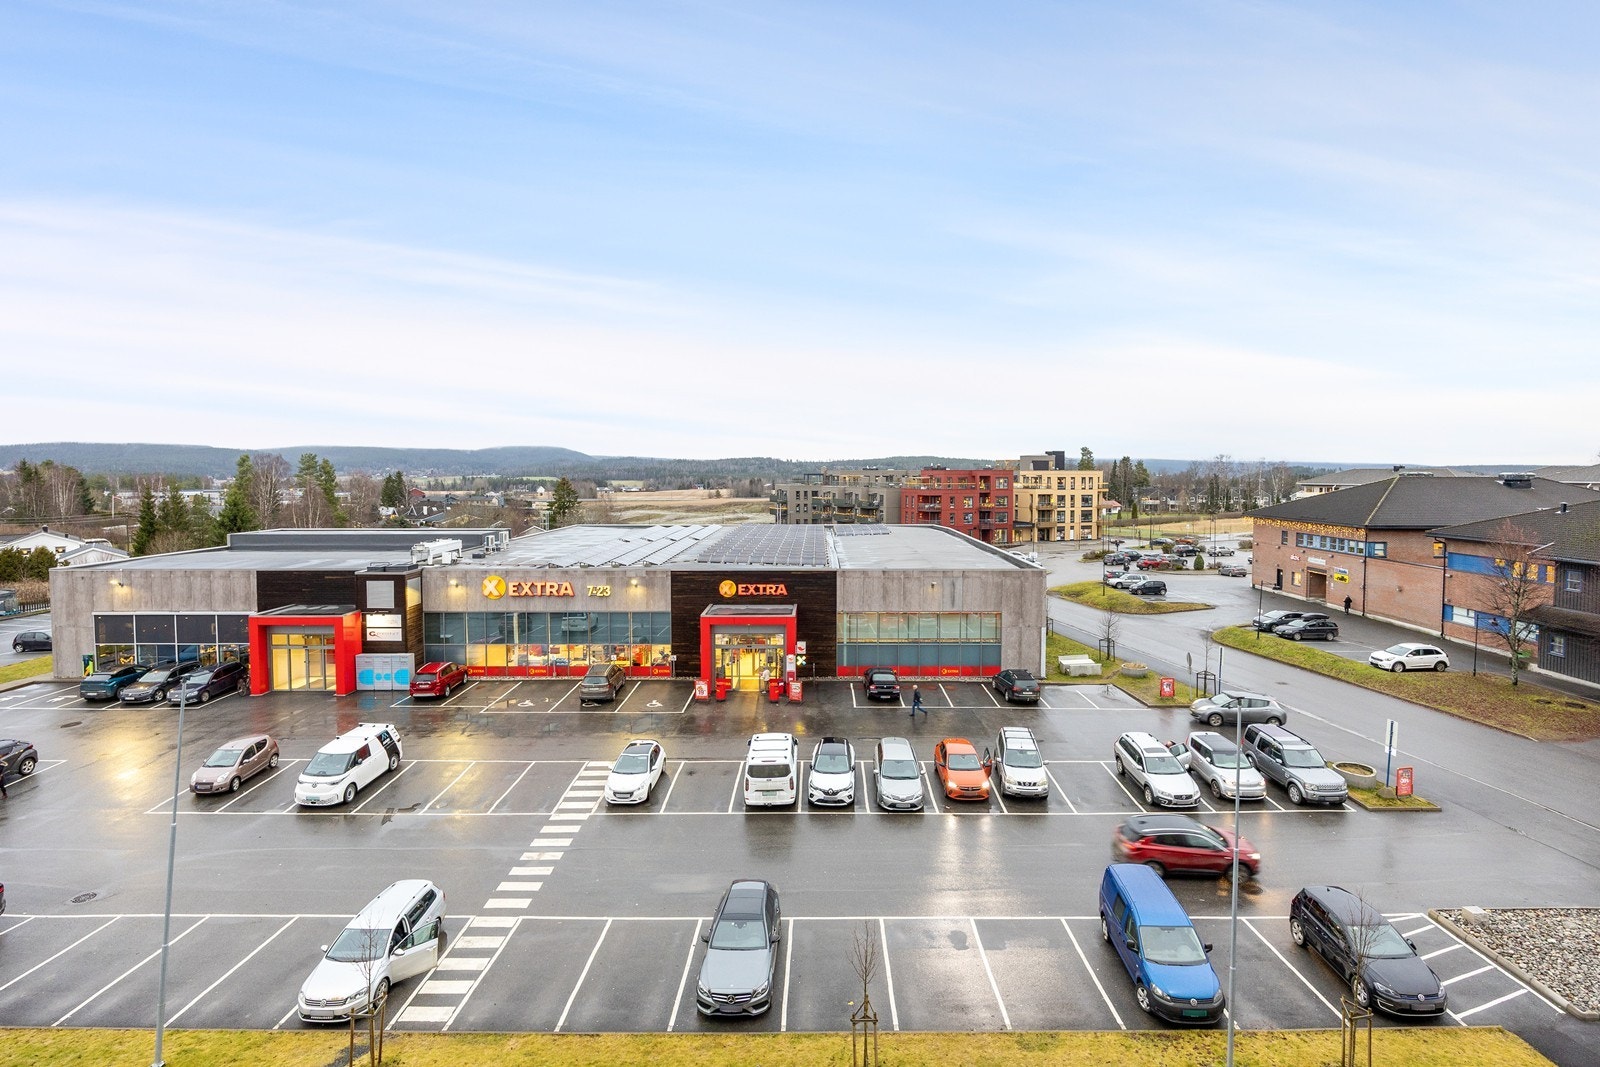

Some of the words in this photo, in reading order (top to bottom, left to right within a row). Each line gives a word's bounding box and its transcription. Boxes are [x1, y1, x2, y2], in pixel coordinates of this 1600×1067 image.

[508, 582, 574, 597] EXTRA
[586, 585, 611, 597] 7-23
[738, 584, 787, 596] EXTRA
